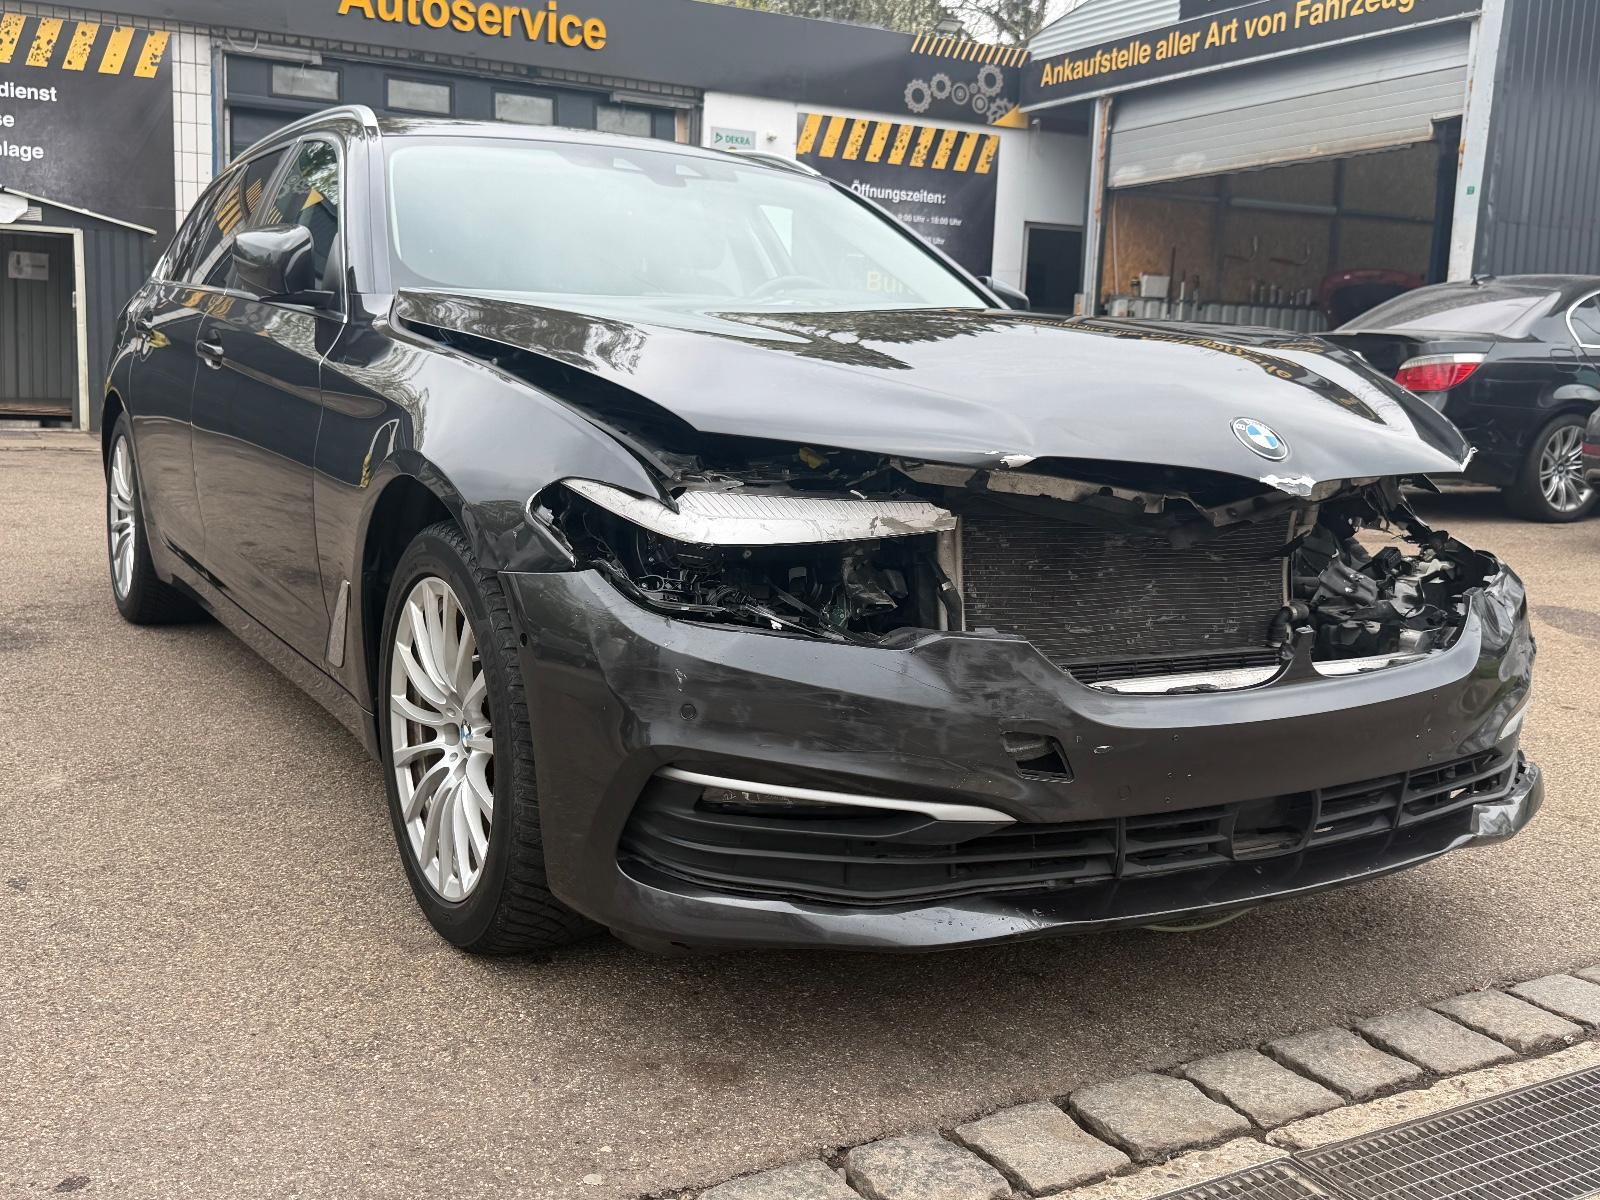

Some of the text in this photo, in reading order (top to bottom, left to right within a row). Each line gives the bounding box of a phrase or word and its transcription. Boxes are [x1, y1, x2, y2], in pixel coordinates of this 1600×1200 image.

[1040, 41, 1151, 87] Ankaufstelle
[1155, 30, 1201, 61] aller
[1204, 18, 1239, 49] Art
[1244, 11, 1287, 40] von
[725, 135, 751, 145] DEKRA
[850, 179, 947, 204] Öffnungszeiten:
[913, 215, 926, 224] Uhr
[949, 218, 962, 226] Uhr
